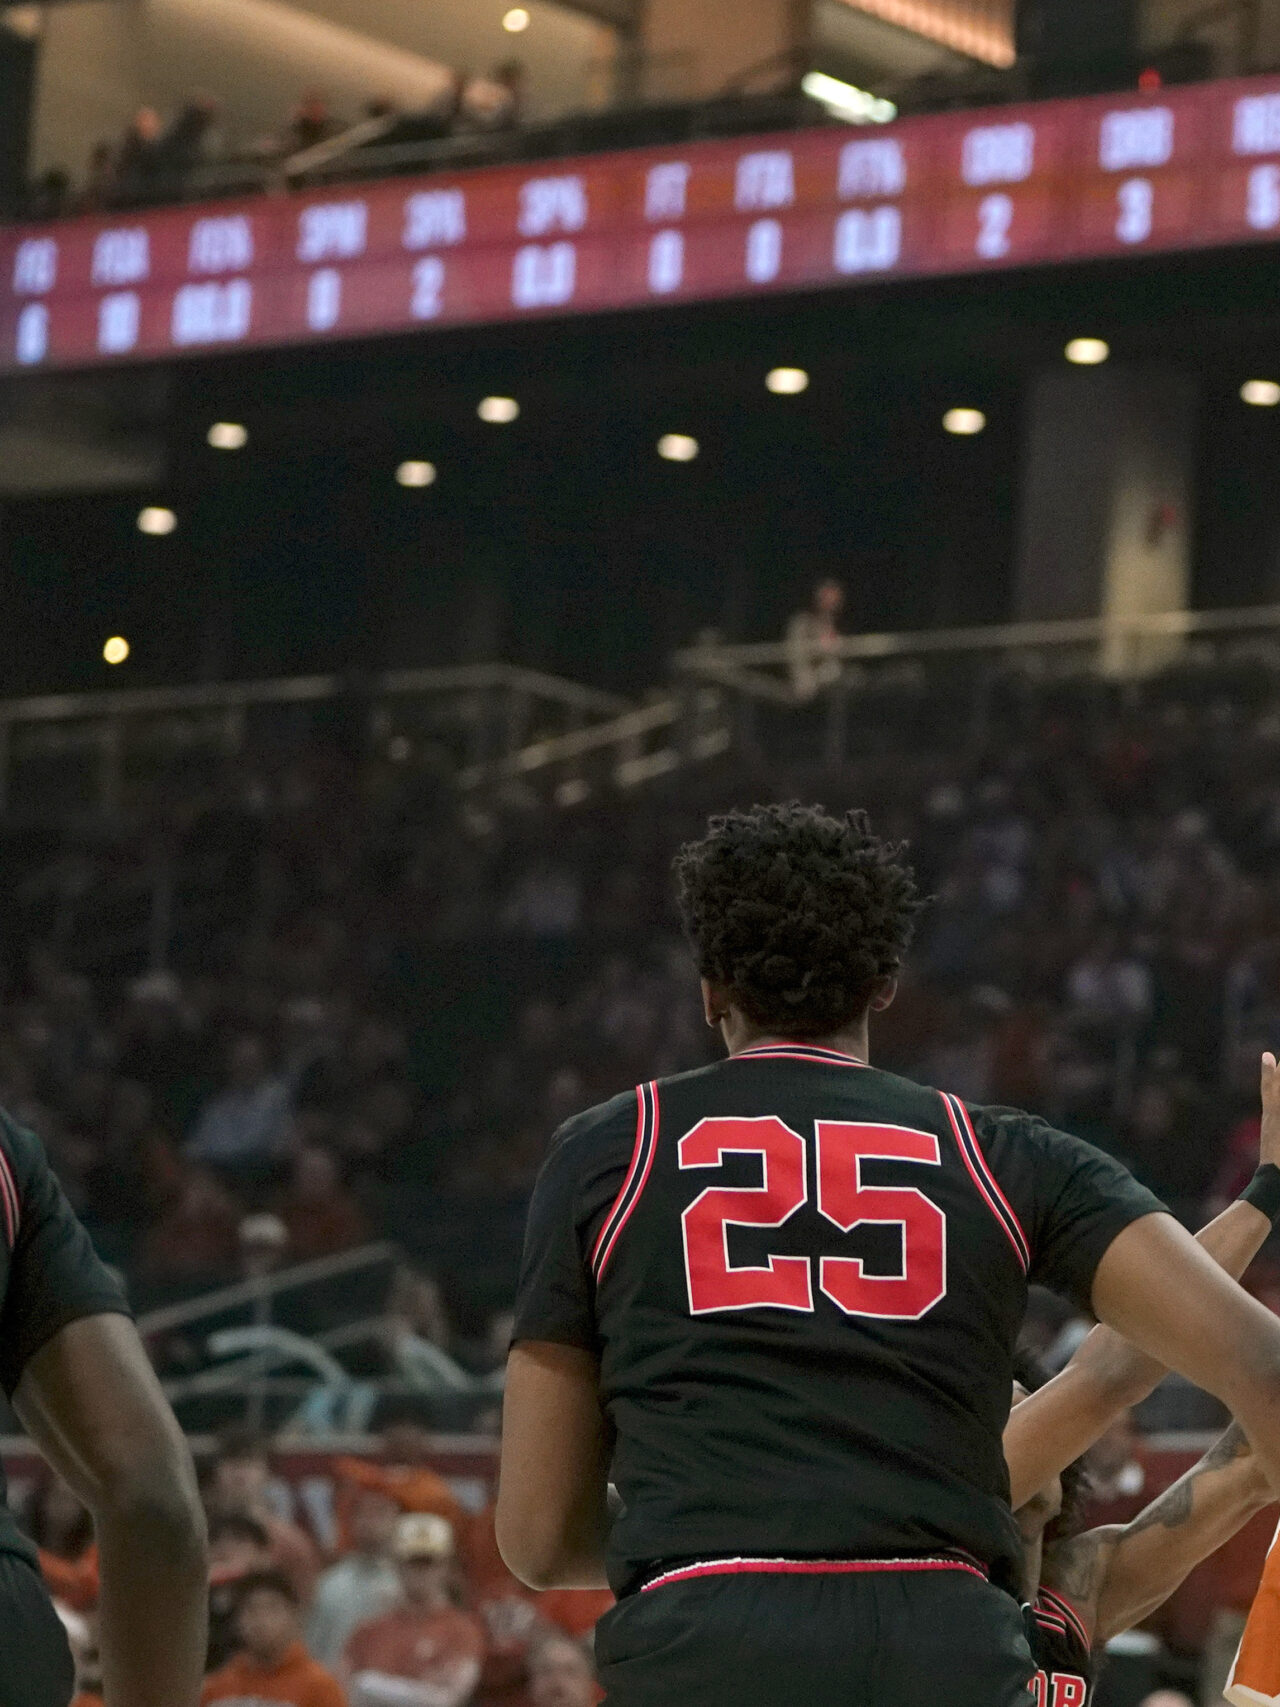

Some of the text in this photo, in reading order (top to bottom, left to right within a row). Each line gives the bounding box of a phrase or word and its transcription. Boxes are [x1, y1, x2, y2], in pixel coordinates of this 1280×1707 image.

[411, 256, 445, 321] 2
[975, 193, 1014, 259] 2
[1115, 177, 1153, 244] 3
[677, 1115, 947, 1320] 25
